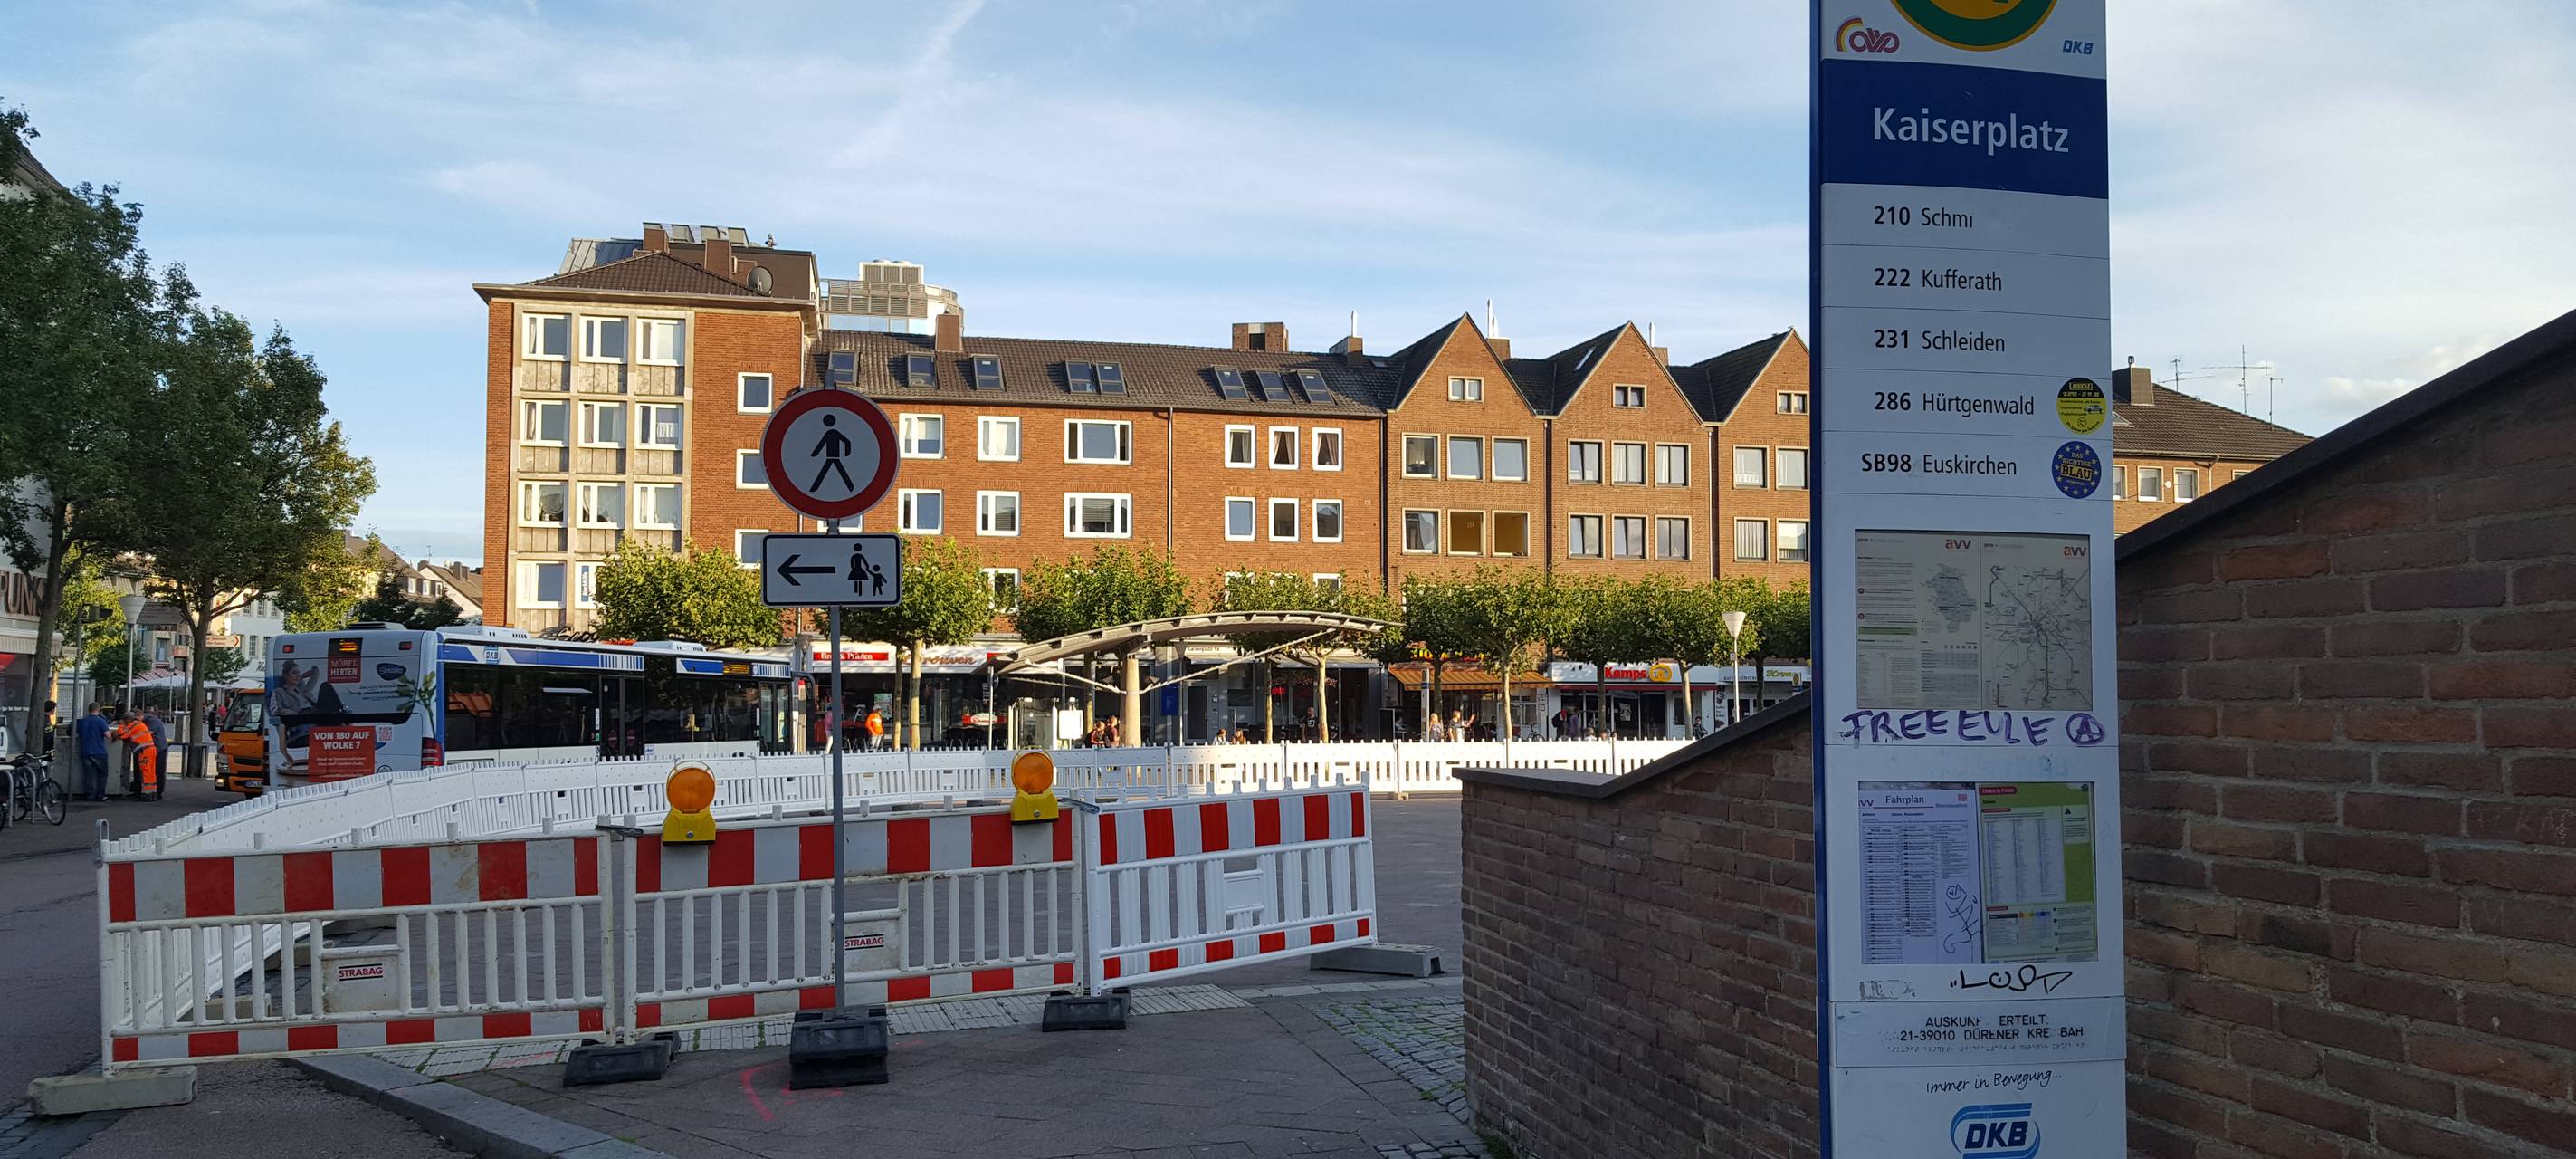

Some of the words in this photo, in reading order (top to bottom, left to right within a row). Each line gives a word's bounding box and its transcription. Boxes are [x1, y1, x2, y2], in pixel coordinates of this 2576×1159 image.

[2062, 39, 2094, 54] DKB
[1874, 107, 2069, 156] Kaiserplatz
[1874, 206, 1911, 225] 210
[1874, 268, 1911, 286] 222
[1922, 269, 2002, 291] Kufferath
[1874, 329, 1909, 349] 231
[1922, 330, 2006, 352] Schleiden
[1874, 392, 1912, 411] 286
[1922, 393, 2035, 417] Hürtgenwald
[1861, 453, 1912, 473] SB98
[1922, 455, 2017, 475] Euskirchen
[2061, 465, 2092, 480] BLAU
[1605, 666, 1647, 681] Kamps
[314, 732, 333, 740] VON
[336, 732, 350, 740] 180
[353, 731, 370, 740] AUF
[323, 742, 354, 750] WOLKE
[1885, 795, 1924, 805] Fahrplan
[844, 935, 885, 948] STRABAG
[338, 965, 384, 978] STRABAG
[1926, 1081, 1970, 1094] Immer
[1975, 1073, 1989, 1088] in
[1964, 1121, 2029, 1150] DKB
